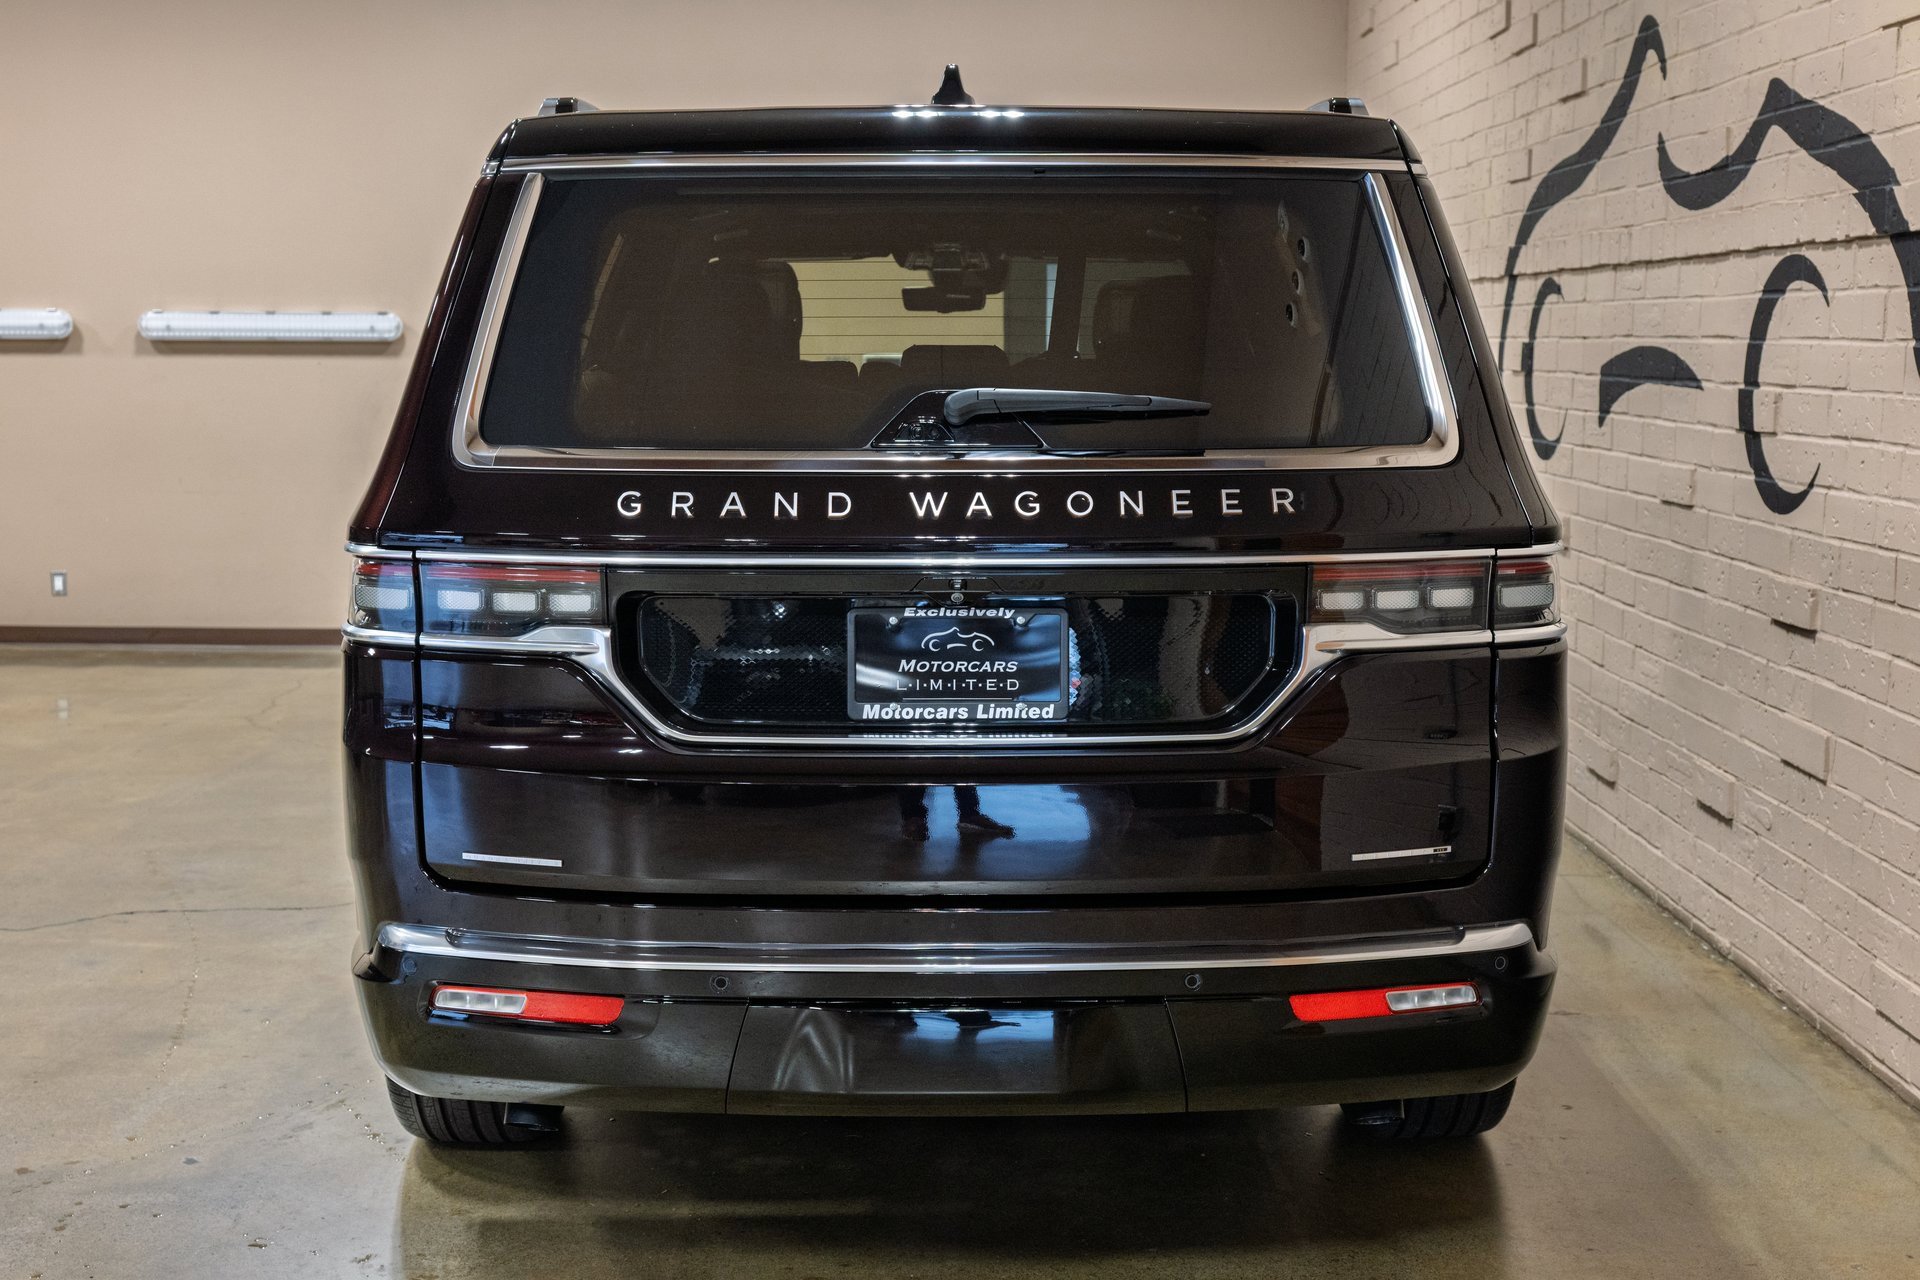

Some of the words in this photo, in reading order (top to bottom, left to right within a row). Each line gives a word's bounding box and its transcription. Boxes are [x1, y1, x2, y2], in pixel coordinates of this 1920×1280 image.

[616, 490, 853, 519] GRAND
[909, 488, 1297, 519] WAGONEER
[903, 607, 1016, 619] Exclusively
[898, 659, 1019, 673] MOTORCARS
[862, 704, 969, 720] Motorcars
[976, 704, 1055, 720] Limited
